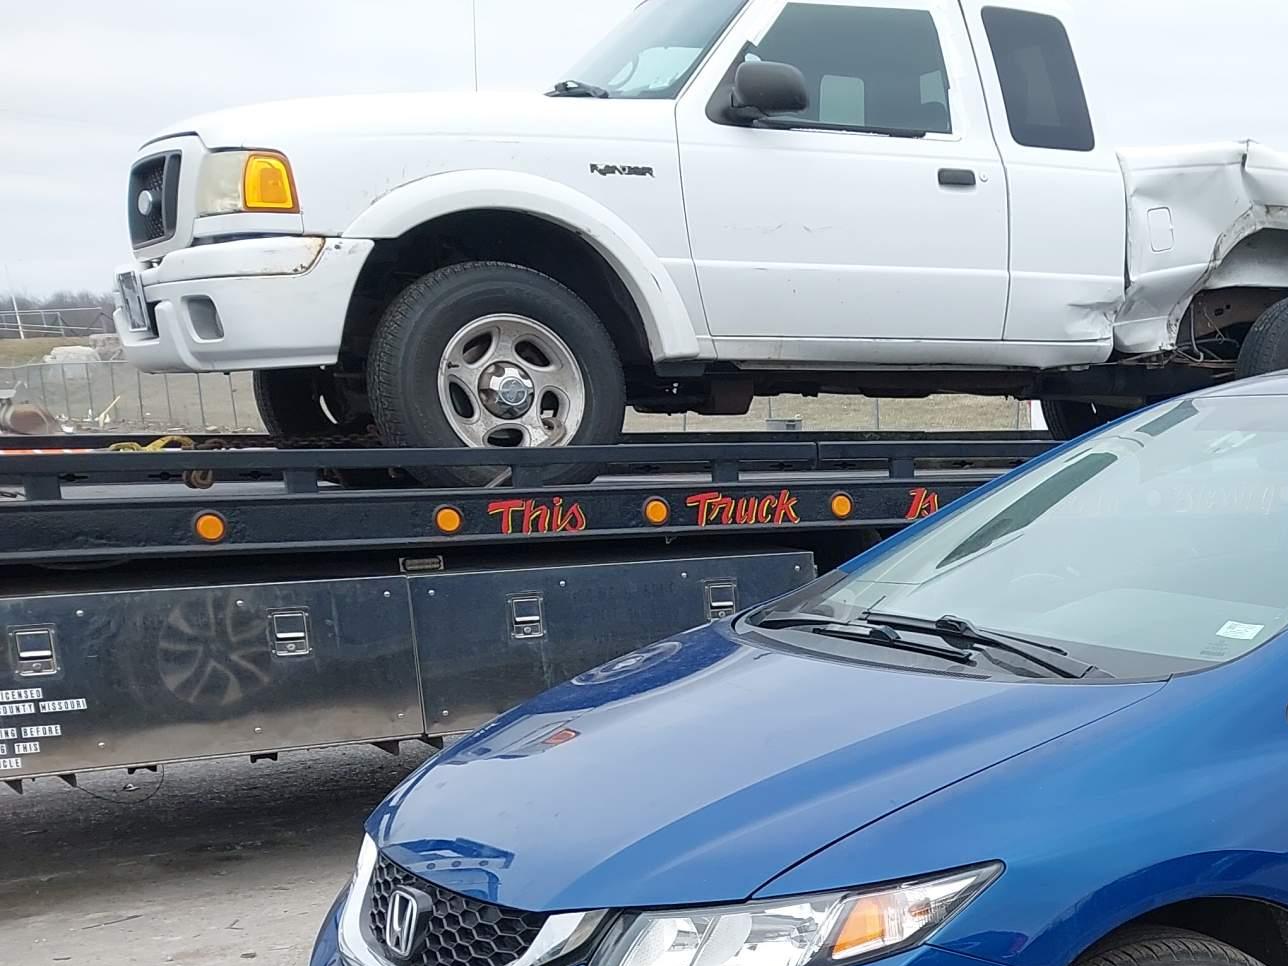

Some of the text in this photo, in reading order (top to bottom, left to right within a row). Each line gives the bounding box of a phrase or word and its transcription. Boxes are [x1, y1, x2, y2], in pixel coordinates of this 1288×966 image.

[487, 496, 586, 536] This
[686, 489, 800, 527] Truck
[40, 699, 87, 712] MISSOURI
[23, 725, 60, 737] BEFORE
[15, 743, 39, 753] THIS
